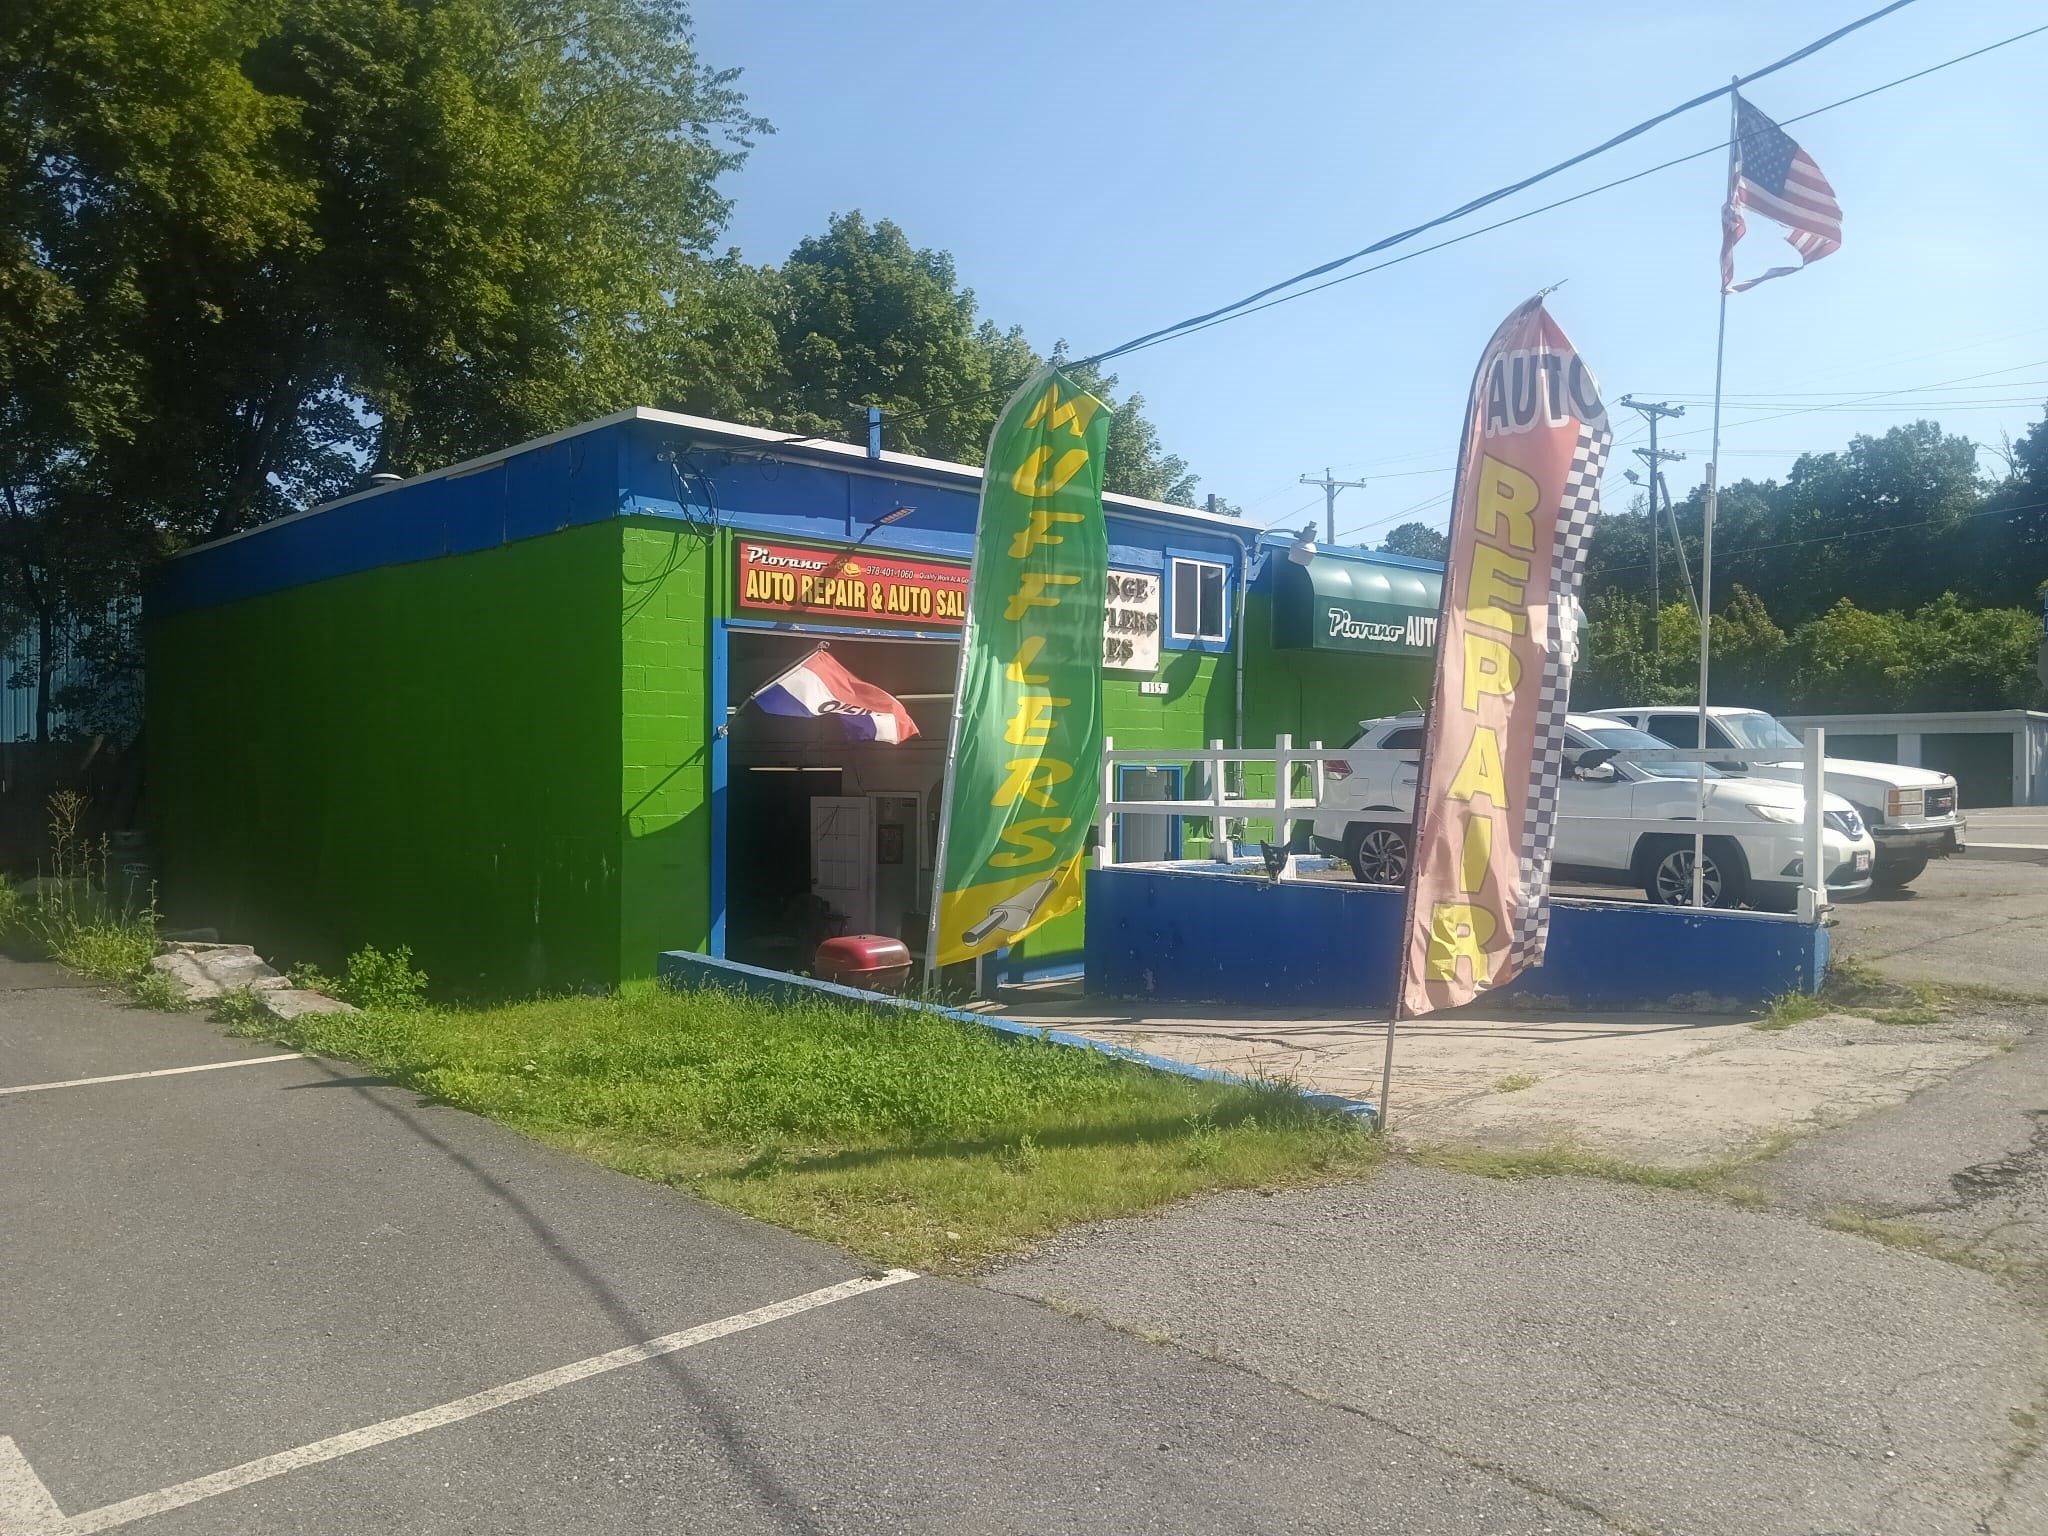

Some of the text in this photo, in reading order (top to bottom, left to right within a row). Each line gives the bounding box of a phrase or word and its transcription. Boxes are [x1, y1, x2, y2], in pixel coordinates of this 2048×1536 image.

[1484, 348, 1607, 439] AUTO
[746, 545, 829, 571] Piovano
[745, 569, 796, 604] AUTO
[801, 575, 867, 610] REPAIR
[870, 582, 884, 611] &
[887, 583, 932, 616] AUTO
[988, 383, 1099, 868] MUFFLERS
[1104, 607, 1158, 638] LERS
[1329, 607, 1404, 642] Piovano
[1424, 452, 1542, 984] REPAIR
